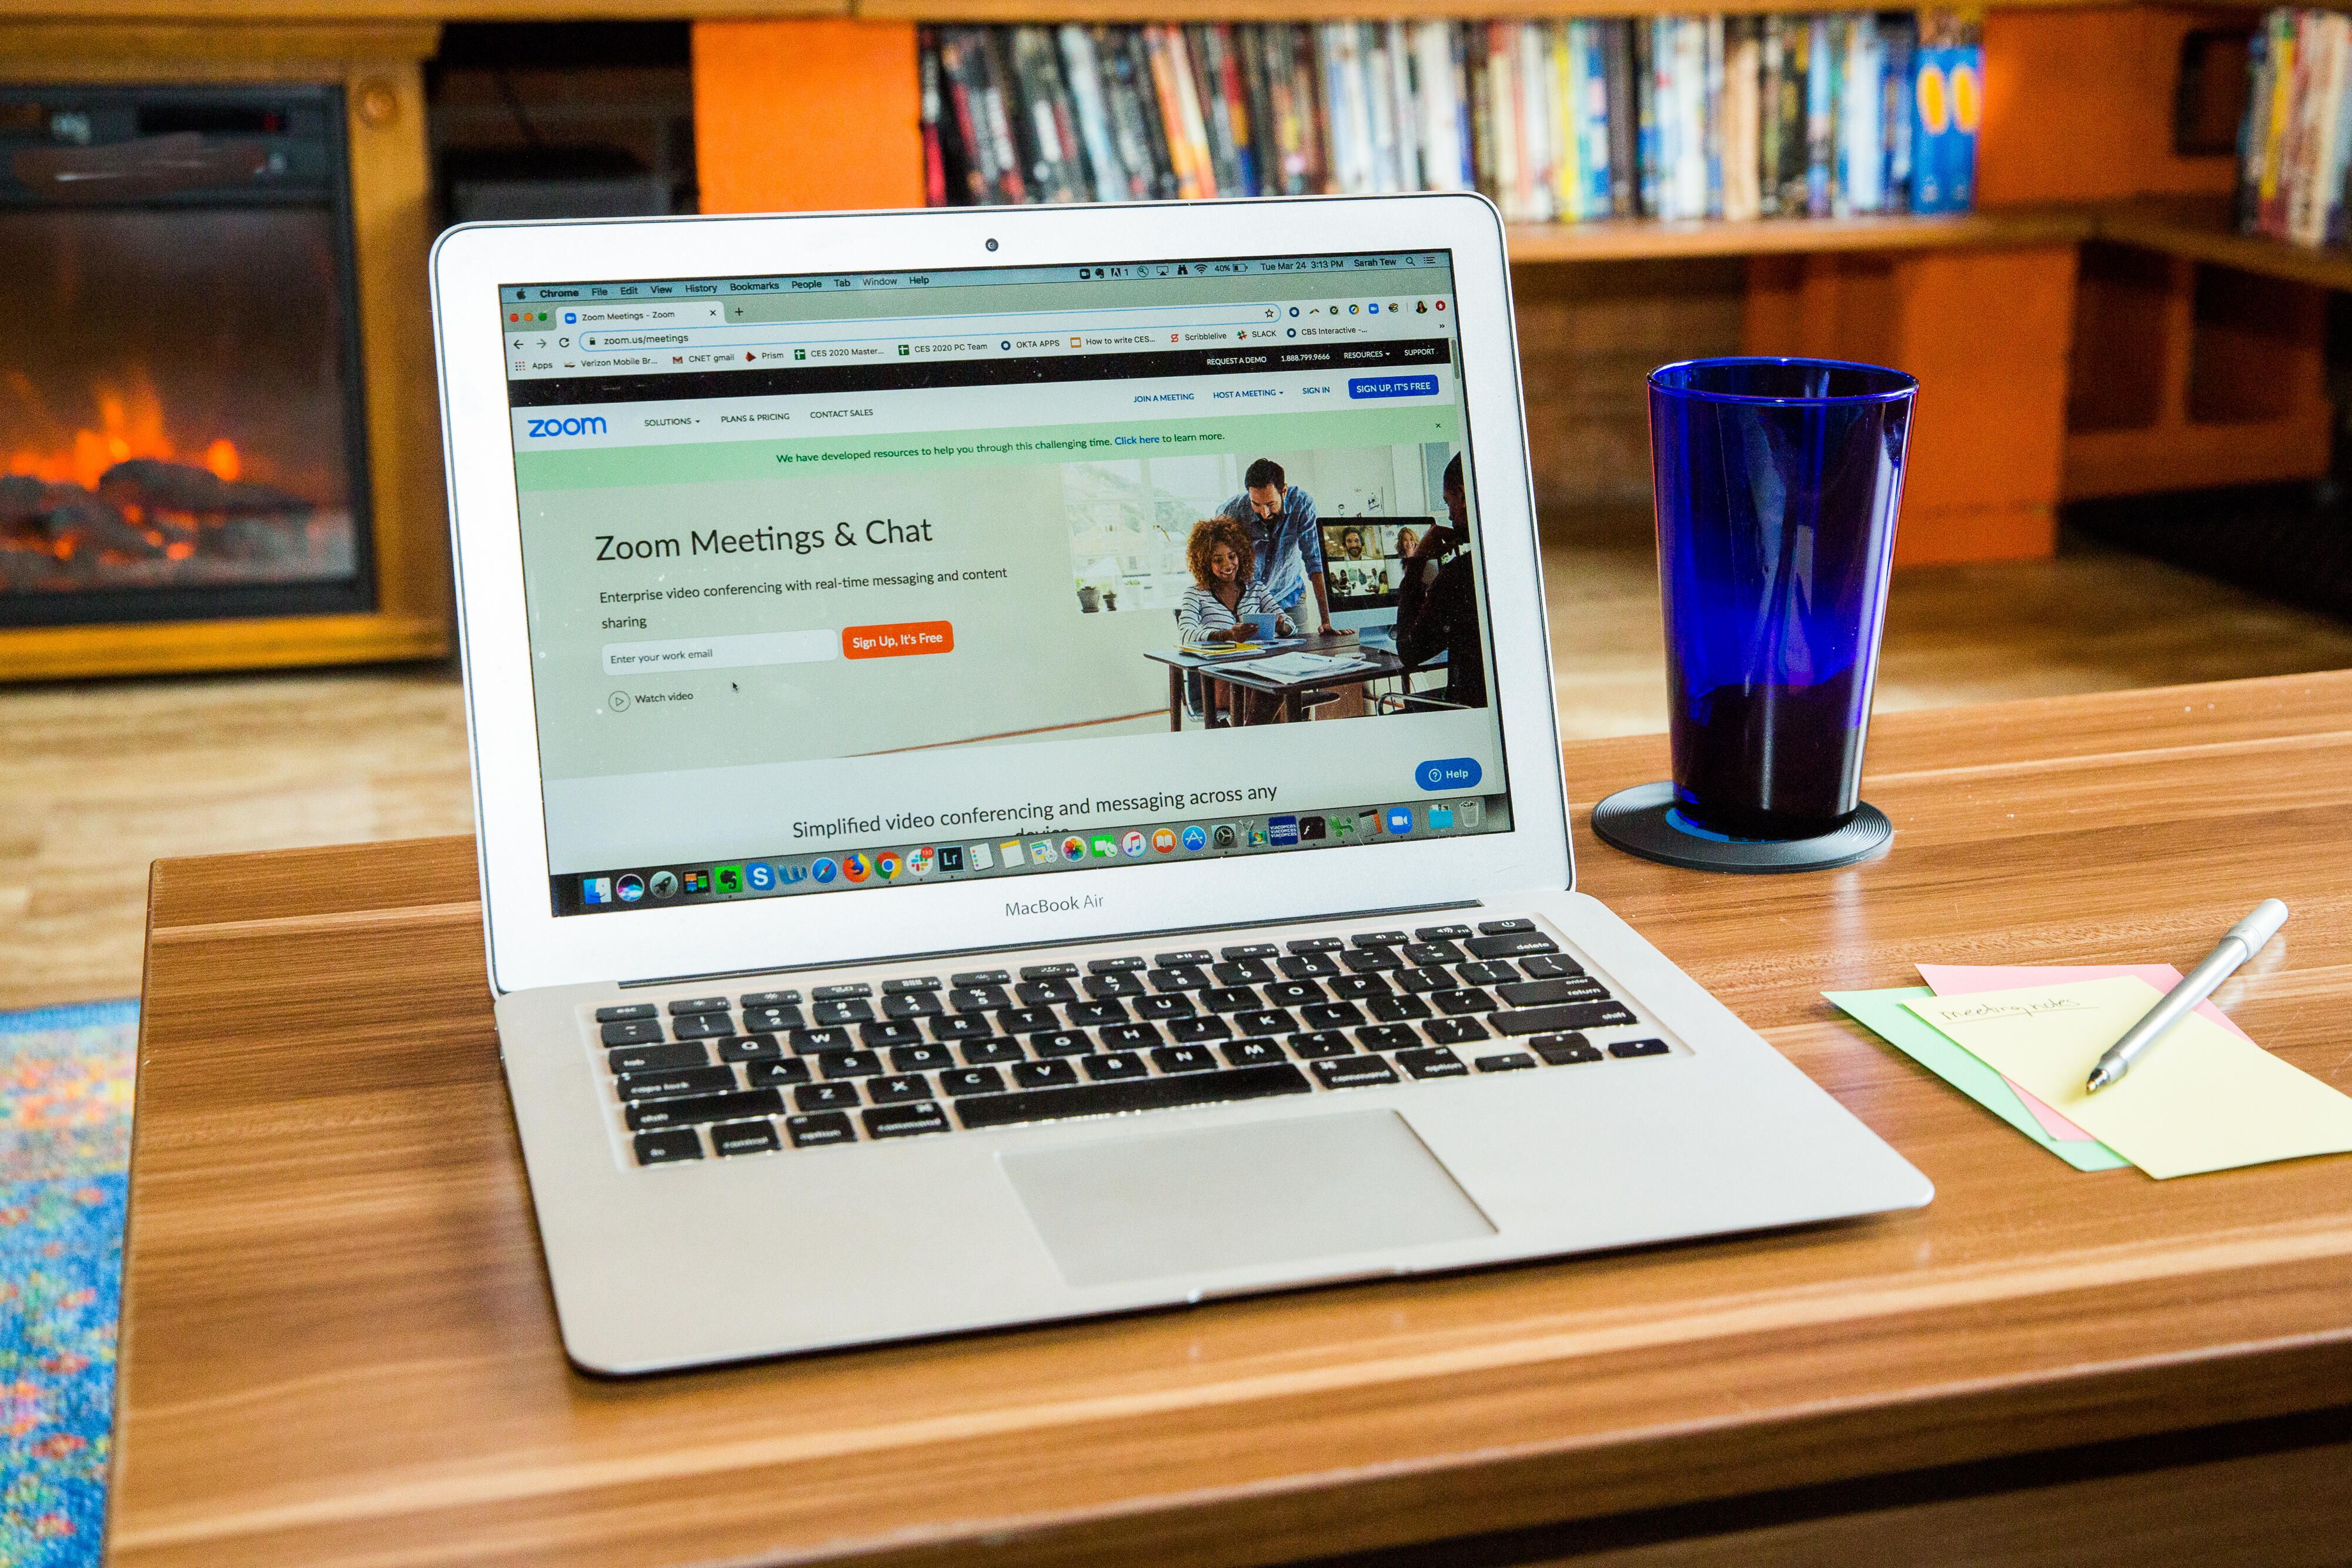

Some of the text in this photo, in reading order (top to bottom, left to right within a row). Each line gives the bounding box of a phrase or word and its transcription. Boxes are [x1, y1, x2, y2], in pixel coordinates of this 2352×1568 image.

[540, 276, 929, 297] Chrome File Edit View History Bookmarks People Tab Window Help
[582, 310, 674, 322] Zoom Meetings Zoom
[1252, 329, 1277, 338] SLACK
[1318, 326, 1356, 335] Interactive
[604, 333, 688, 346] zoom.us/meetings
[1086, 334, 1155, 346] How to write CES...
[1185, 332, 1227, 342] Scribblelive
[914, 342, 987, 353] CES 2020 PC Team
[1017, 339, 1060, 349] OKTA APPS
[761, 352, 784, 360] Prism
[828, 349, 848, 357] 2020
[851, 347, 884, 356] Master...
[580, 359, 611, 367] Verizon
[642, 357, 657, 365] Br...
[689, 353, 734, 363] CNET gmail
[1207, 357, 1238, 365] REQUEST
[532, 361, 553, 370] Apps
[1357, 384, 1377, 393] SIGN
[1378, 383, 1392, 393] UP,
[1410, 382, 1431, 390] FREE
[1134, 394, 1151, 403] JOIN
[1160, 393, 1194, 401] MEETING
[1214, 390, 1234, 399] HOST
[721, 414, 747, 423] PLANS
[757, 413, 790, 422] PRICING
[810, 409, 873, 419] CONTACT SALES
[528, 417, 607, 438] zoom
[644, 417, 691, 427] SOLUTIONS
[776, 432, 1225, 463] We have developed resources to help you through this challenging time. Click here to learn more.
[596, 517, 933, 561] Zoom Meetings & Chat
[600, 567, 1007, 604] Enterprise video conferencing with real-time messaging and content
[602, 616, 647, 630] sharing
[852, 632, 943, 651] Sign Up, It's Free
[610, 648, 713, 664] Enter your work email
[634, 691, 693, 704] Watch video
[1446, 768, 1469, 781] Help
[793, 784, 1277, 838] Simplified video conferencing and messaging across any
[943, 852, 957, 865] Lr
[1005, 895, 1104, 917] MacBook Air
[1516, 941, 1549, 950] delete
[1568, 987, 1601, 996] return
